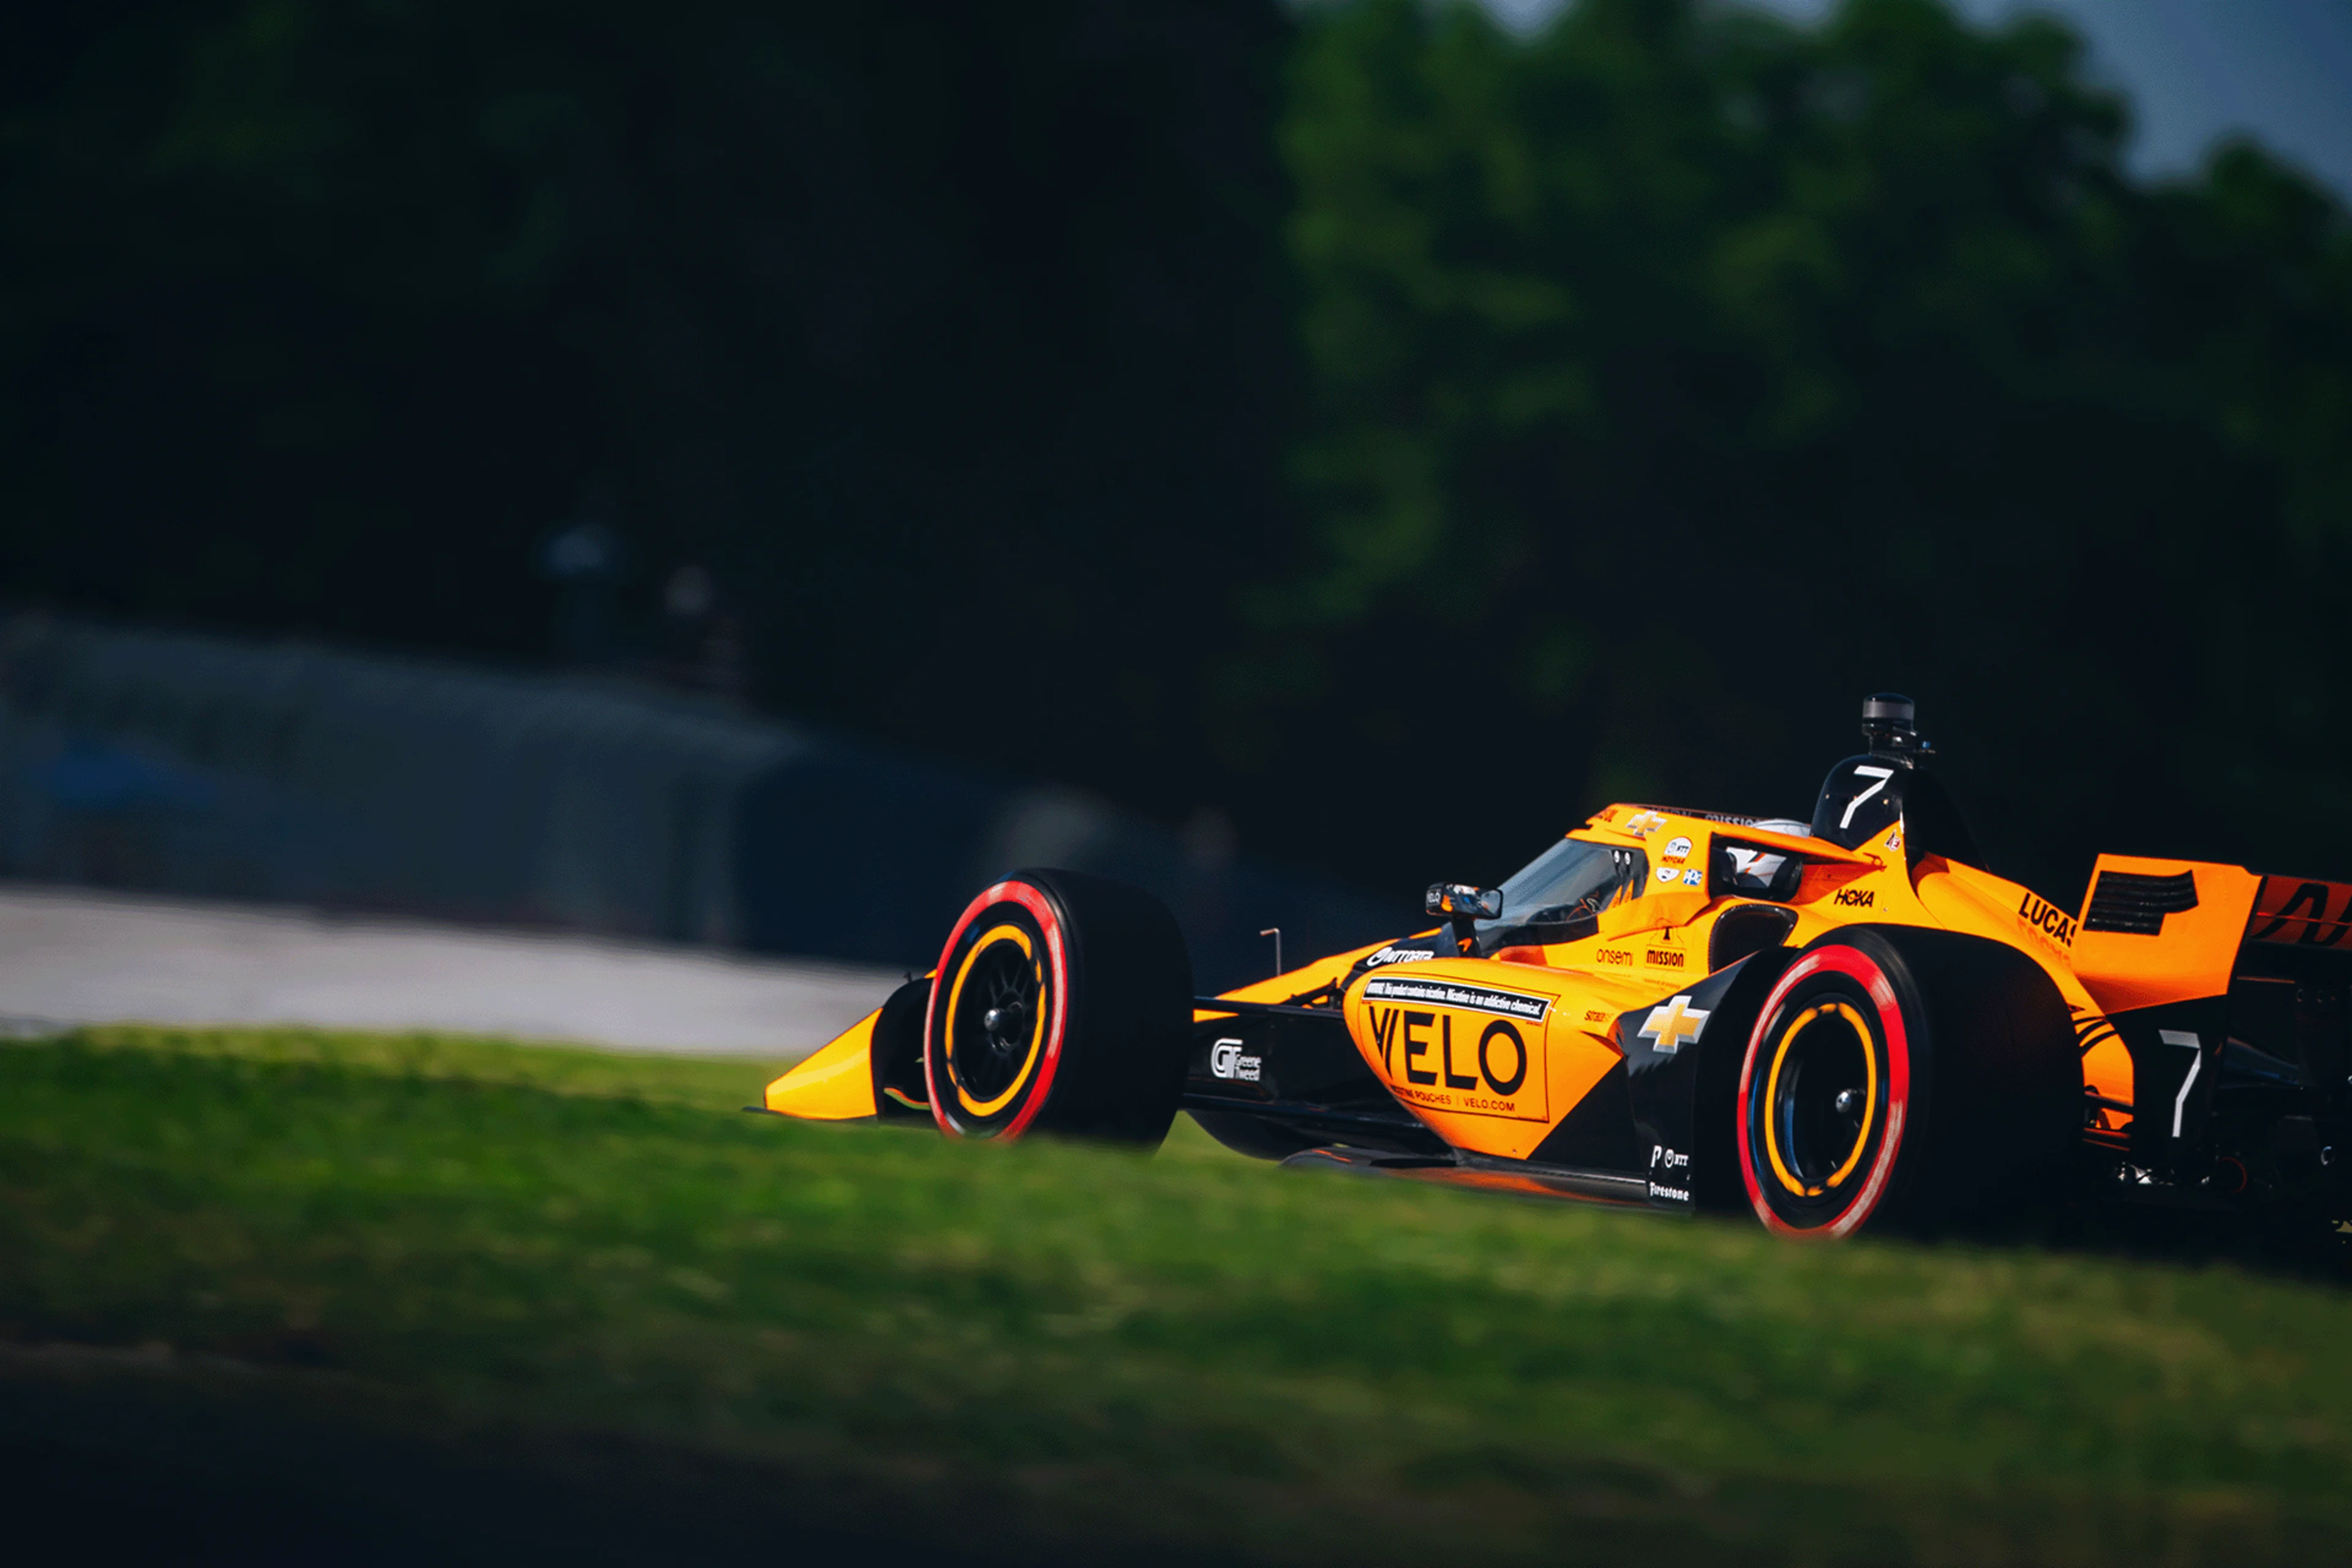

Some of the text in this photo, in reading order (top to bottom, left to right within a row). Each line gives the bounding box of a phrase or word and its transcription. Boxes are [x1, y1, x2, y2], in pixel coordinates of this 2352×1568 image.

[1839, 765, 1894, 829] 7
[1706, 814, 1759, 827] missio
[1833, 889, 1874, 908] HOKA
[1646, 949, 1684, 967] mission
[1369, 1006, 1527, 1096] VELO
[2158, 1029, 2201, 1137] 7
[1415, 1090, 1452, 1104] POUCHES
[1463, 1097, 1515, 1112] VELO.COM
[1649, 1182, 1689, 1201] Firestone
